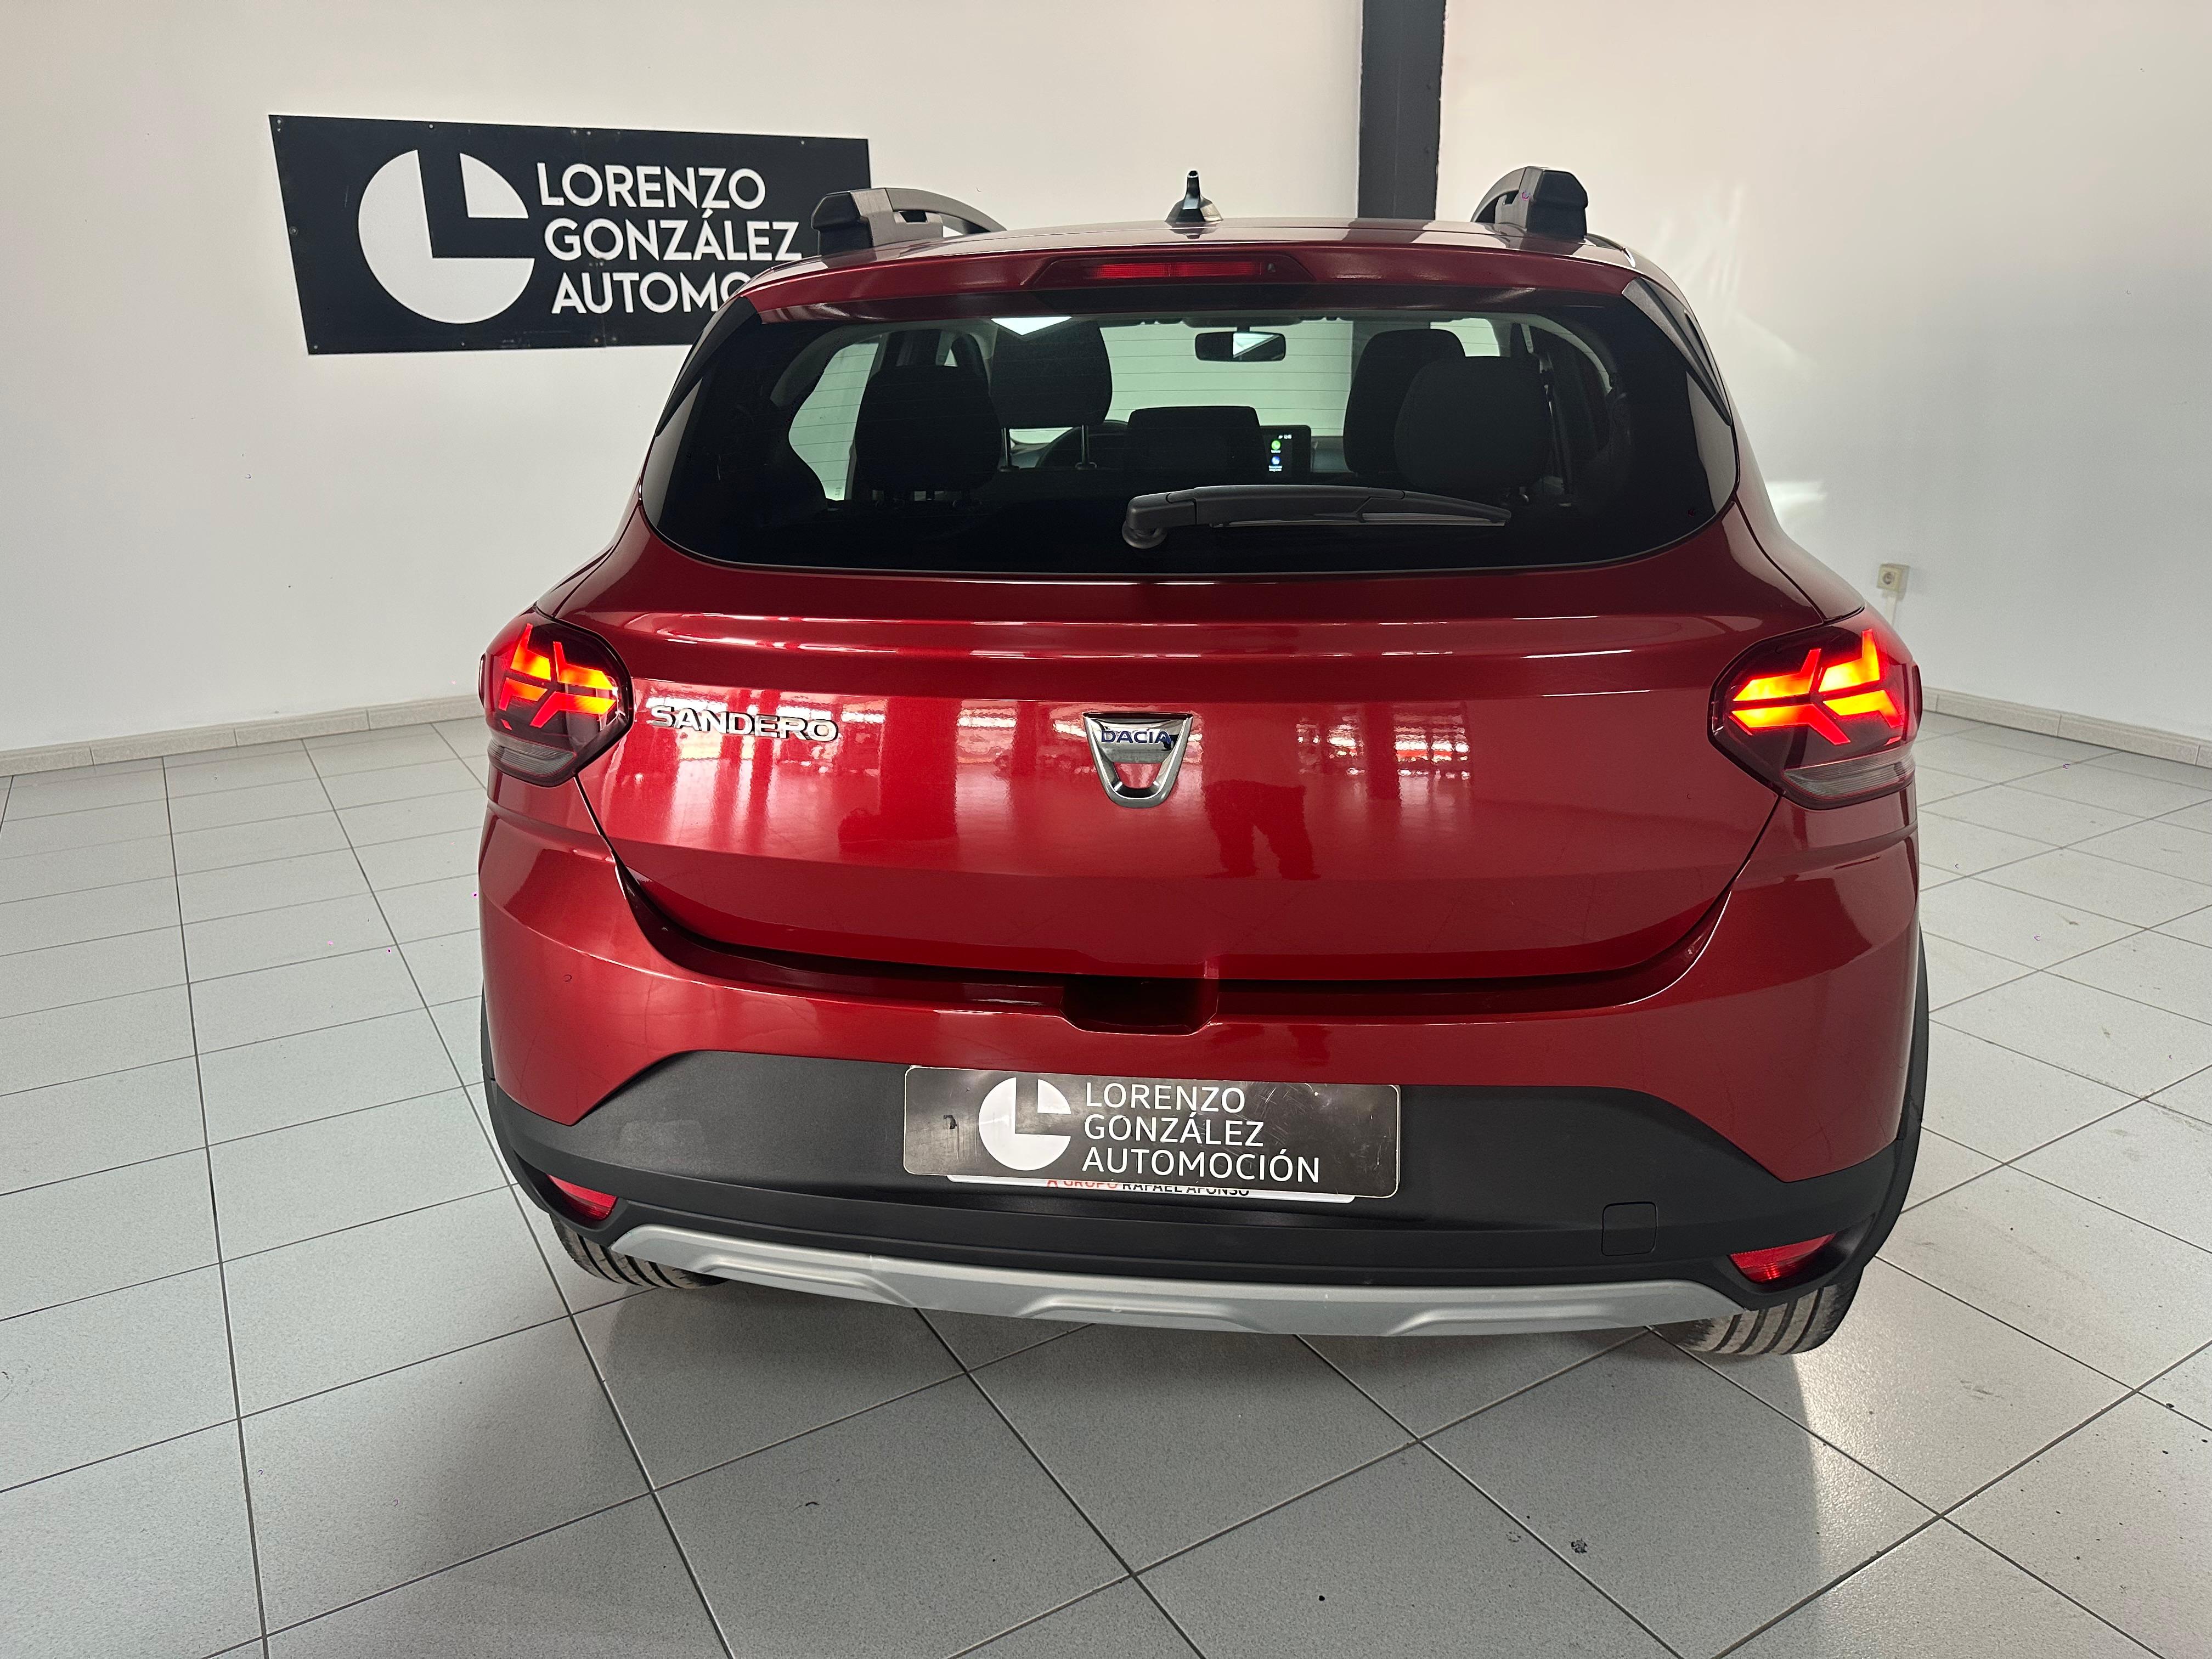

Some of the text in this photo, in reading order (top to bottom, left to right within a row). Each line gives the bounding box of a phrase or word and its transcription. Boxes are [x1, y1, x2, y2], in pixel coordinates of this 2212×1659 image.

[537, 163, 766, 210] LORENZO
[544, 208, 802, 261] GONZÁLEZ
[650, 704, 839, 742] SANDERO
[1101, 730, 1172, 745] DACIA
[1086, 1082, 1245, 1113] LORENZO
[1084, 1111, 1264, 1147] GONZÁLEZ
[1082, 1147, 1319, 1183] AUTOMOCIÓN
